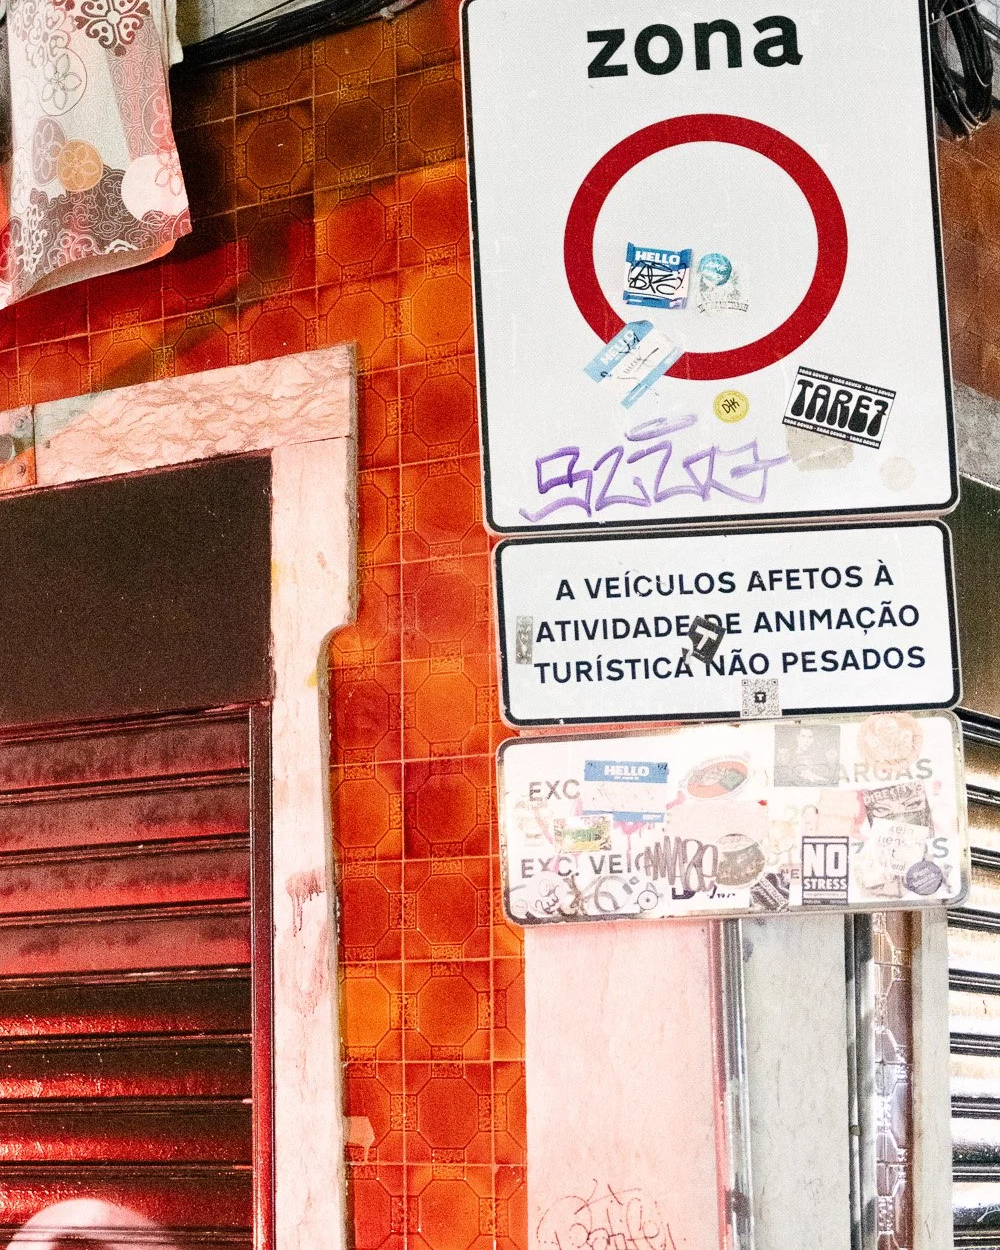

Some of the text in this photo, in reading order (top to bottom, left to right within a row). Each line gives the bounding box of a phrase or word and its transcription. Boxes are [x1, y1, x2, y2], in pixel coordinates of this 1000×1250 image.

[587, 11, 804, 79] zona
[635, 251, 681, 265] HELLO
[790, 379, 889, 437] TARE7
[556, 559, 894, 601] A VEÍCULOS AFETOS À
[535, 615, 690, 643] ATIVIDADE
[753, 600, 920, 636] ANIMAÇÃO
[533, 646, 926, 685] TURÍSTICA NÃO PESADOS
[603, 764, 650, 777] HELLO
[803, 843, 848, 877] NO
[803, 878, 848, 891] STRESS
